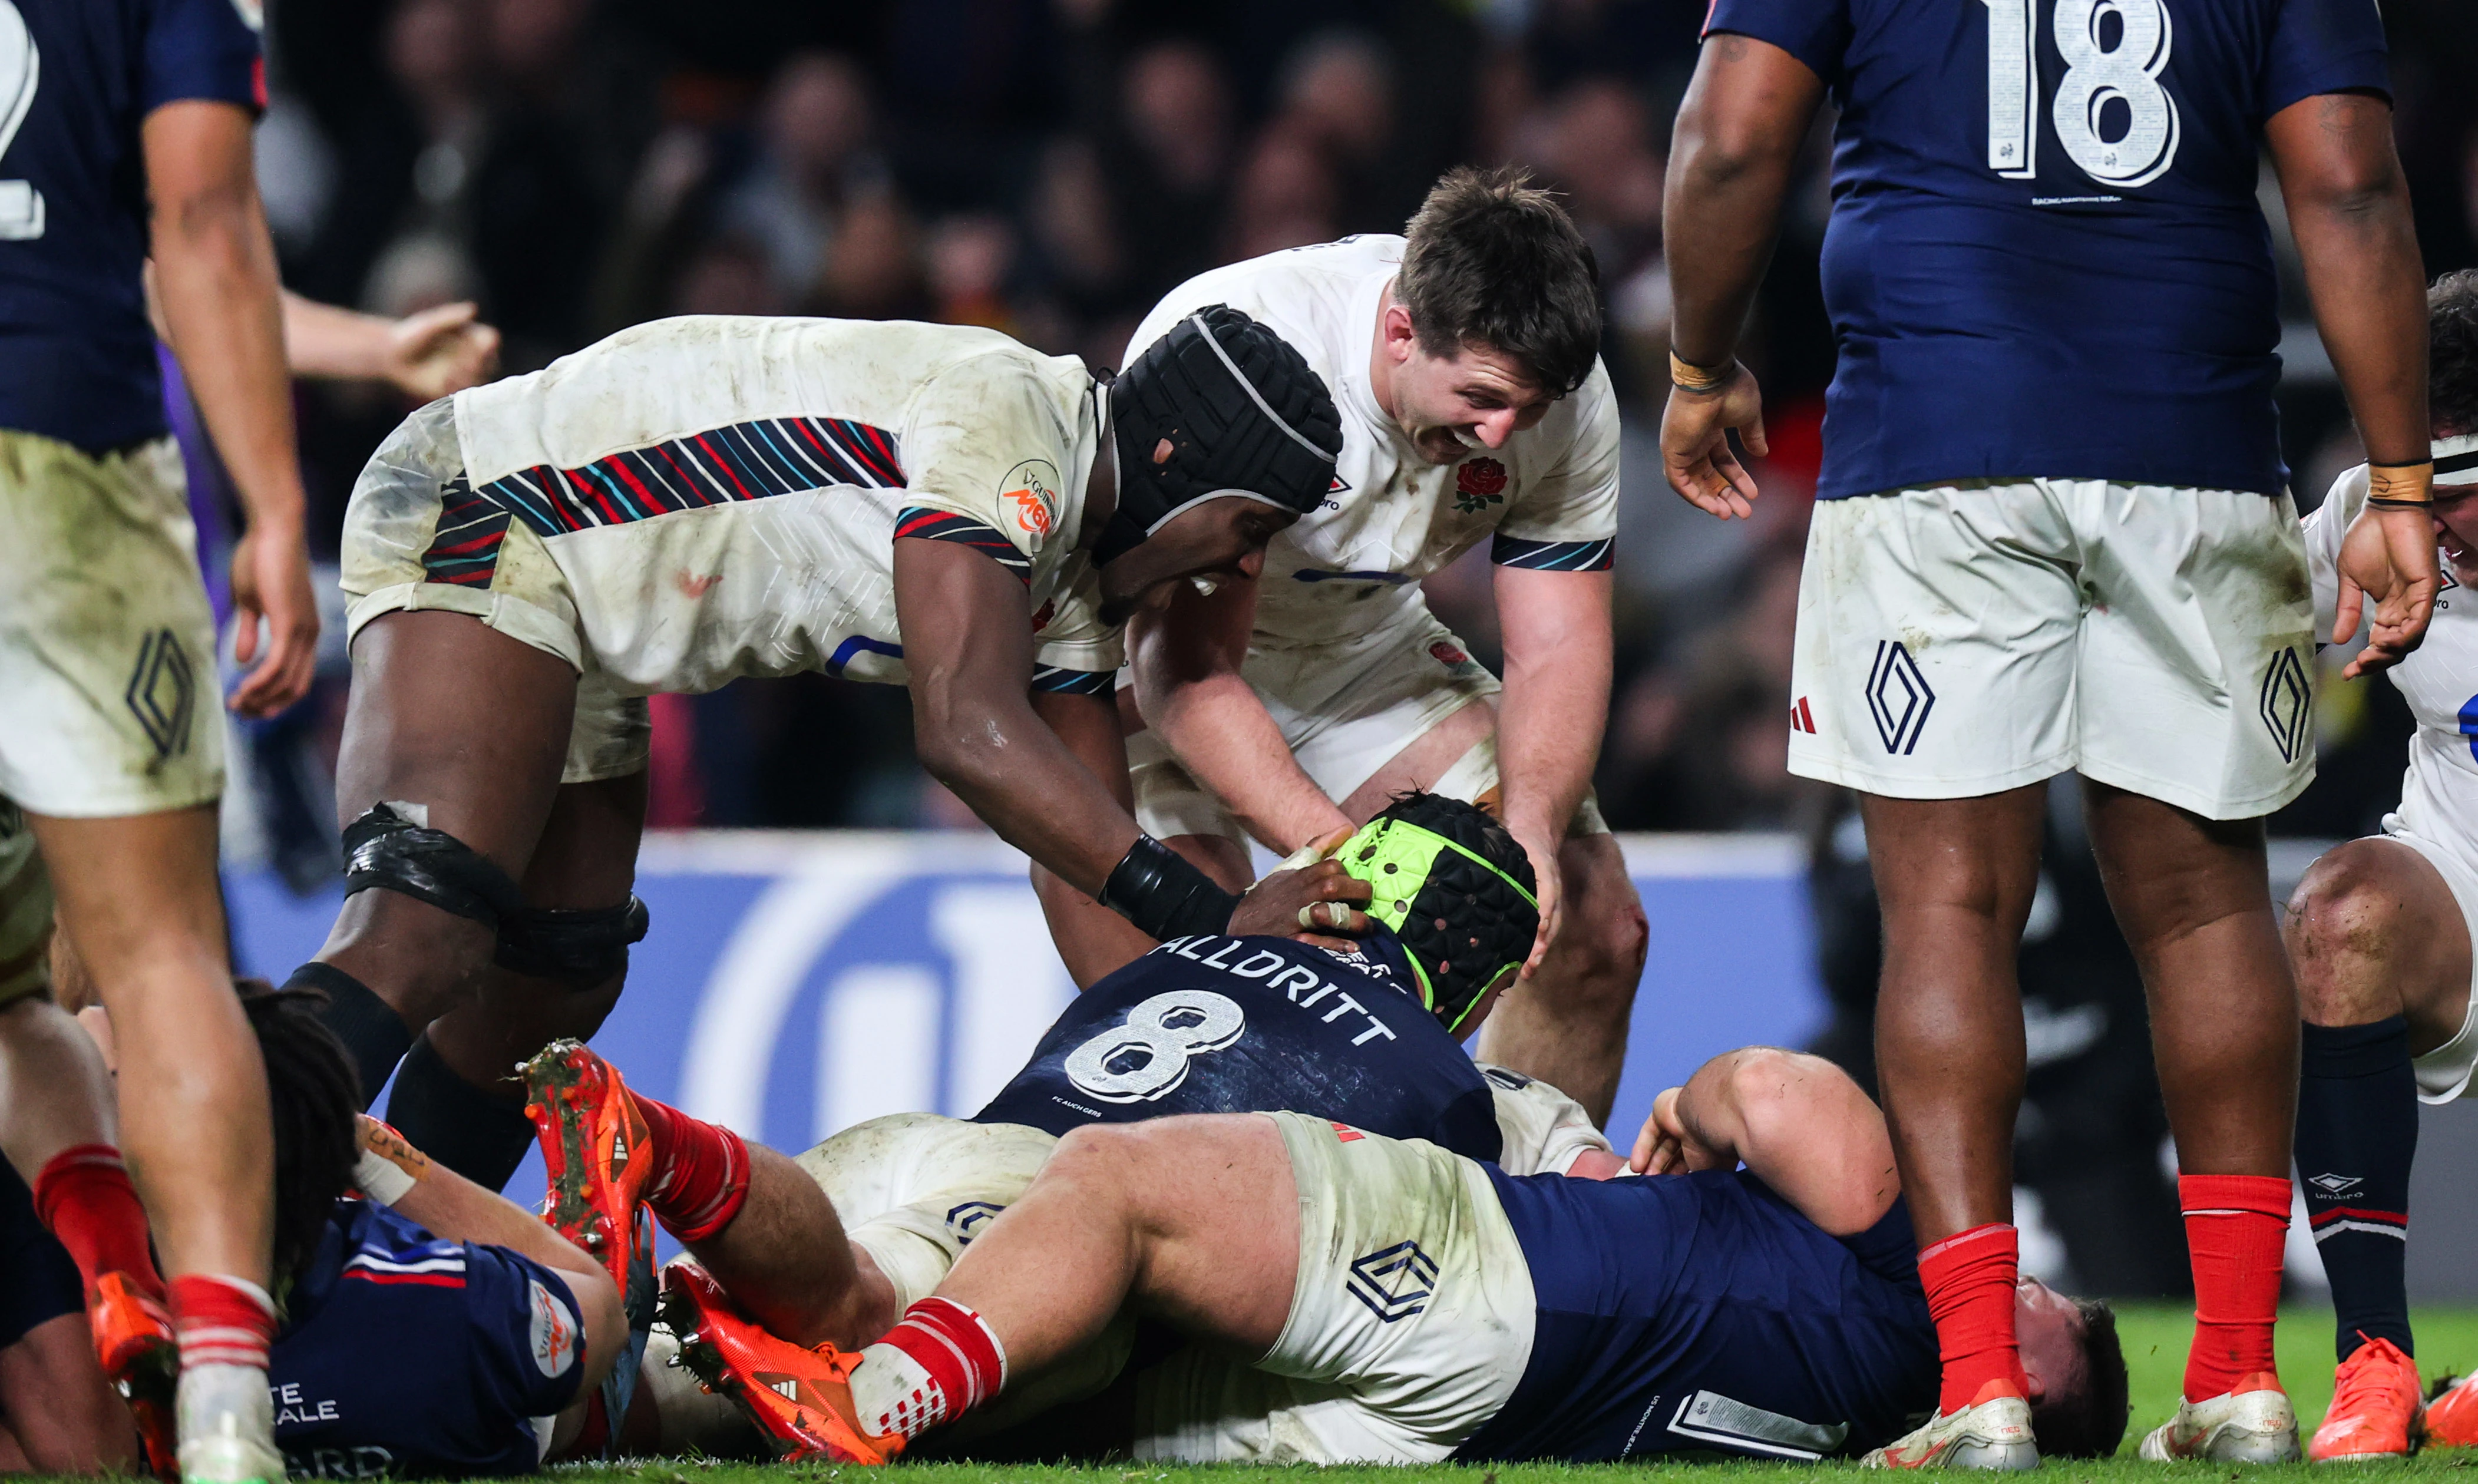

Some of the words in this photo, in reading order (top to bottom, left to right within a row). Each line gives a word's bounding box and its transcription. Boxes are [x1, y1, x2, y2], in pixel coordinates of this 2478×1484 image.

[1980, 0, 2180, 188] 18
[1064, 989, 1245, 1104] 8
[1147, 934, 1397, 1047] ALLDRITT
[1062, 1100, 1084, 1111] AUCH
[1082, 1108, 1102, 1118] GERS
[1650, 1394, 1661, 1406] US
